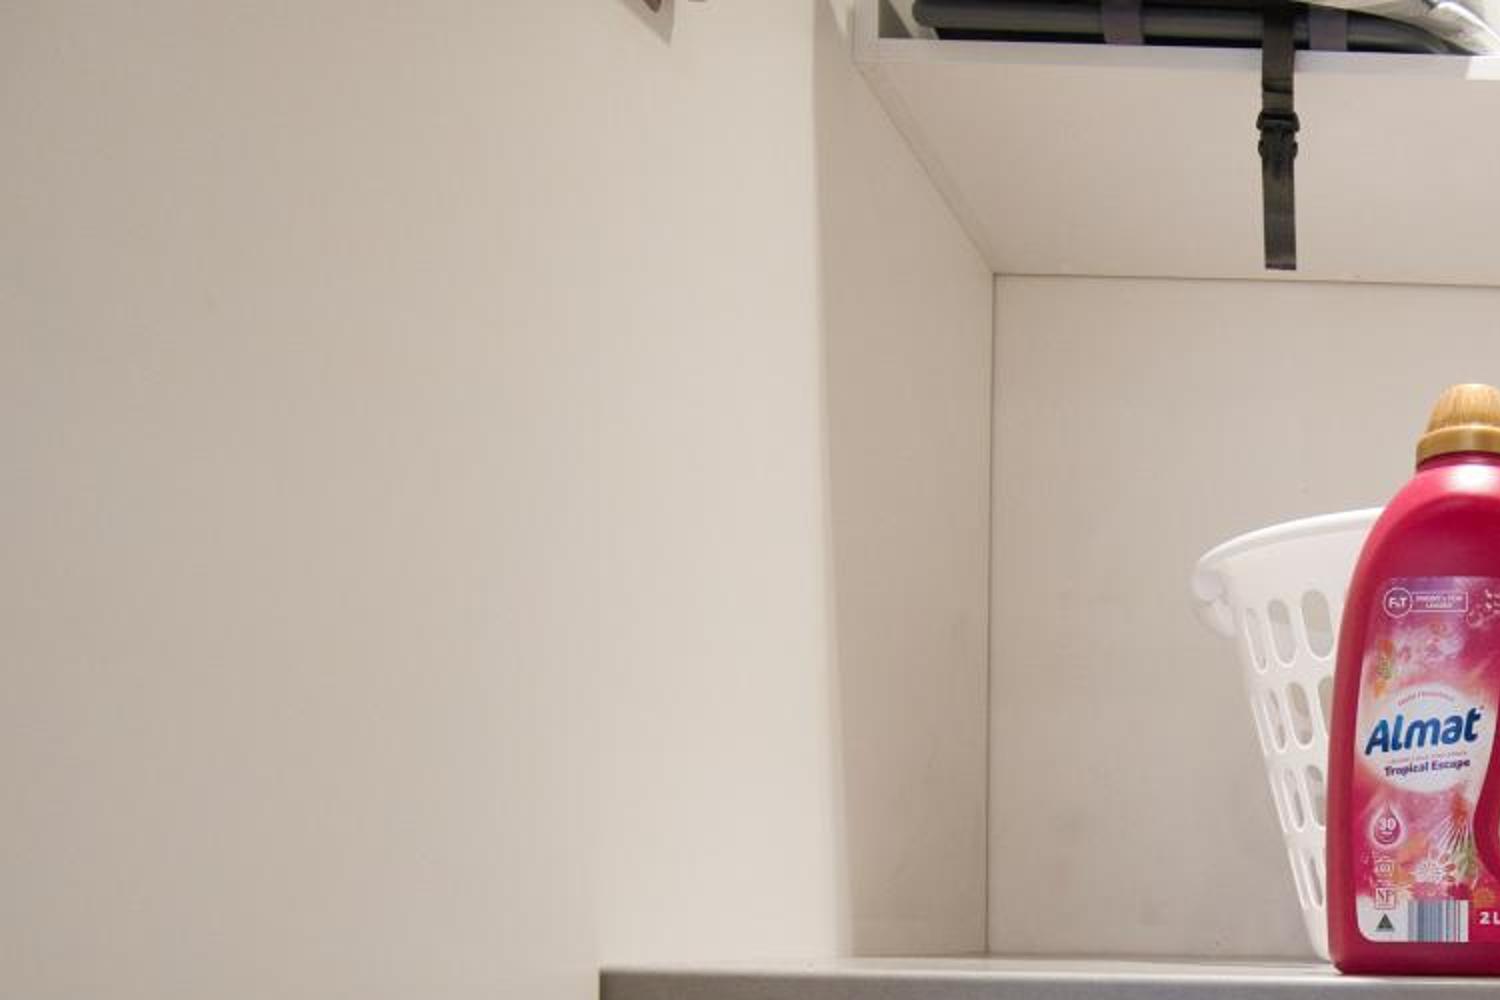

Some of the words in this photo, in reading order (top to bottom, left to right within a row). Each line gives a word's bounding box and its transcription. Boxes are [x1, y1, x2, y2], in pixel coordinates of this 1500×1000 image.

[1364, 707, 1482, 756] Almat
[1384, 761, 1429, 777] Tropical
[1431, 759, 1471, 771] Escape
